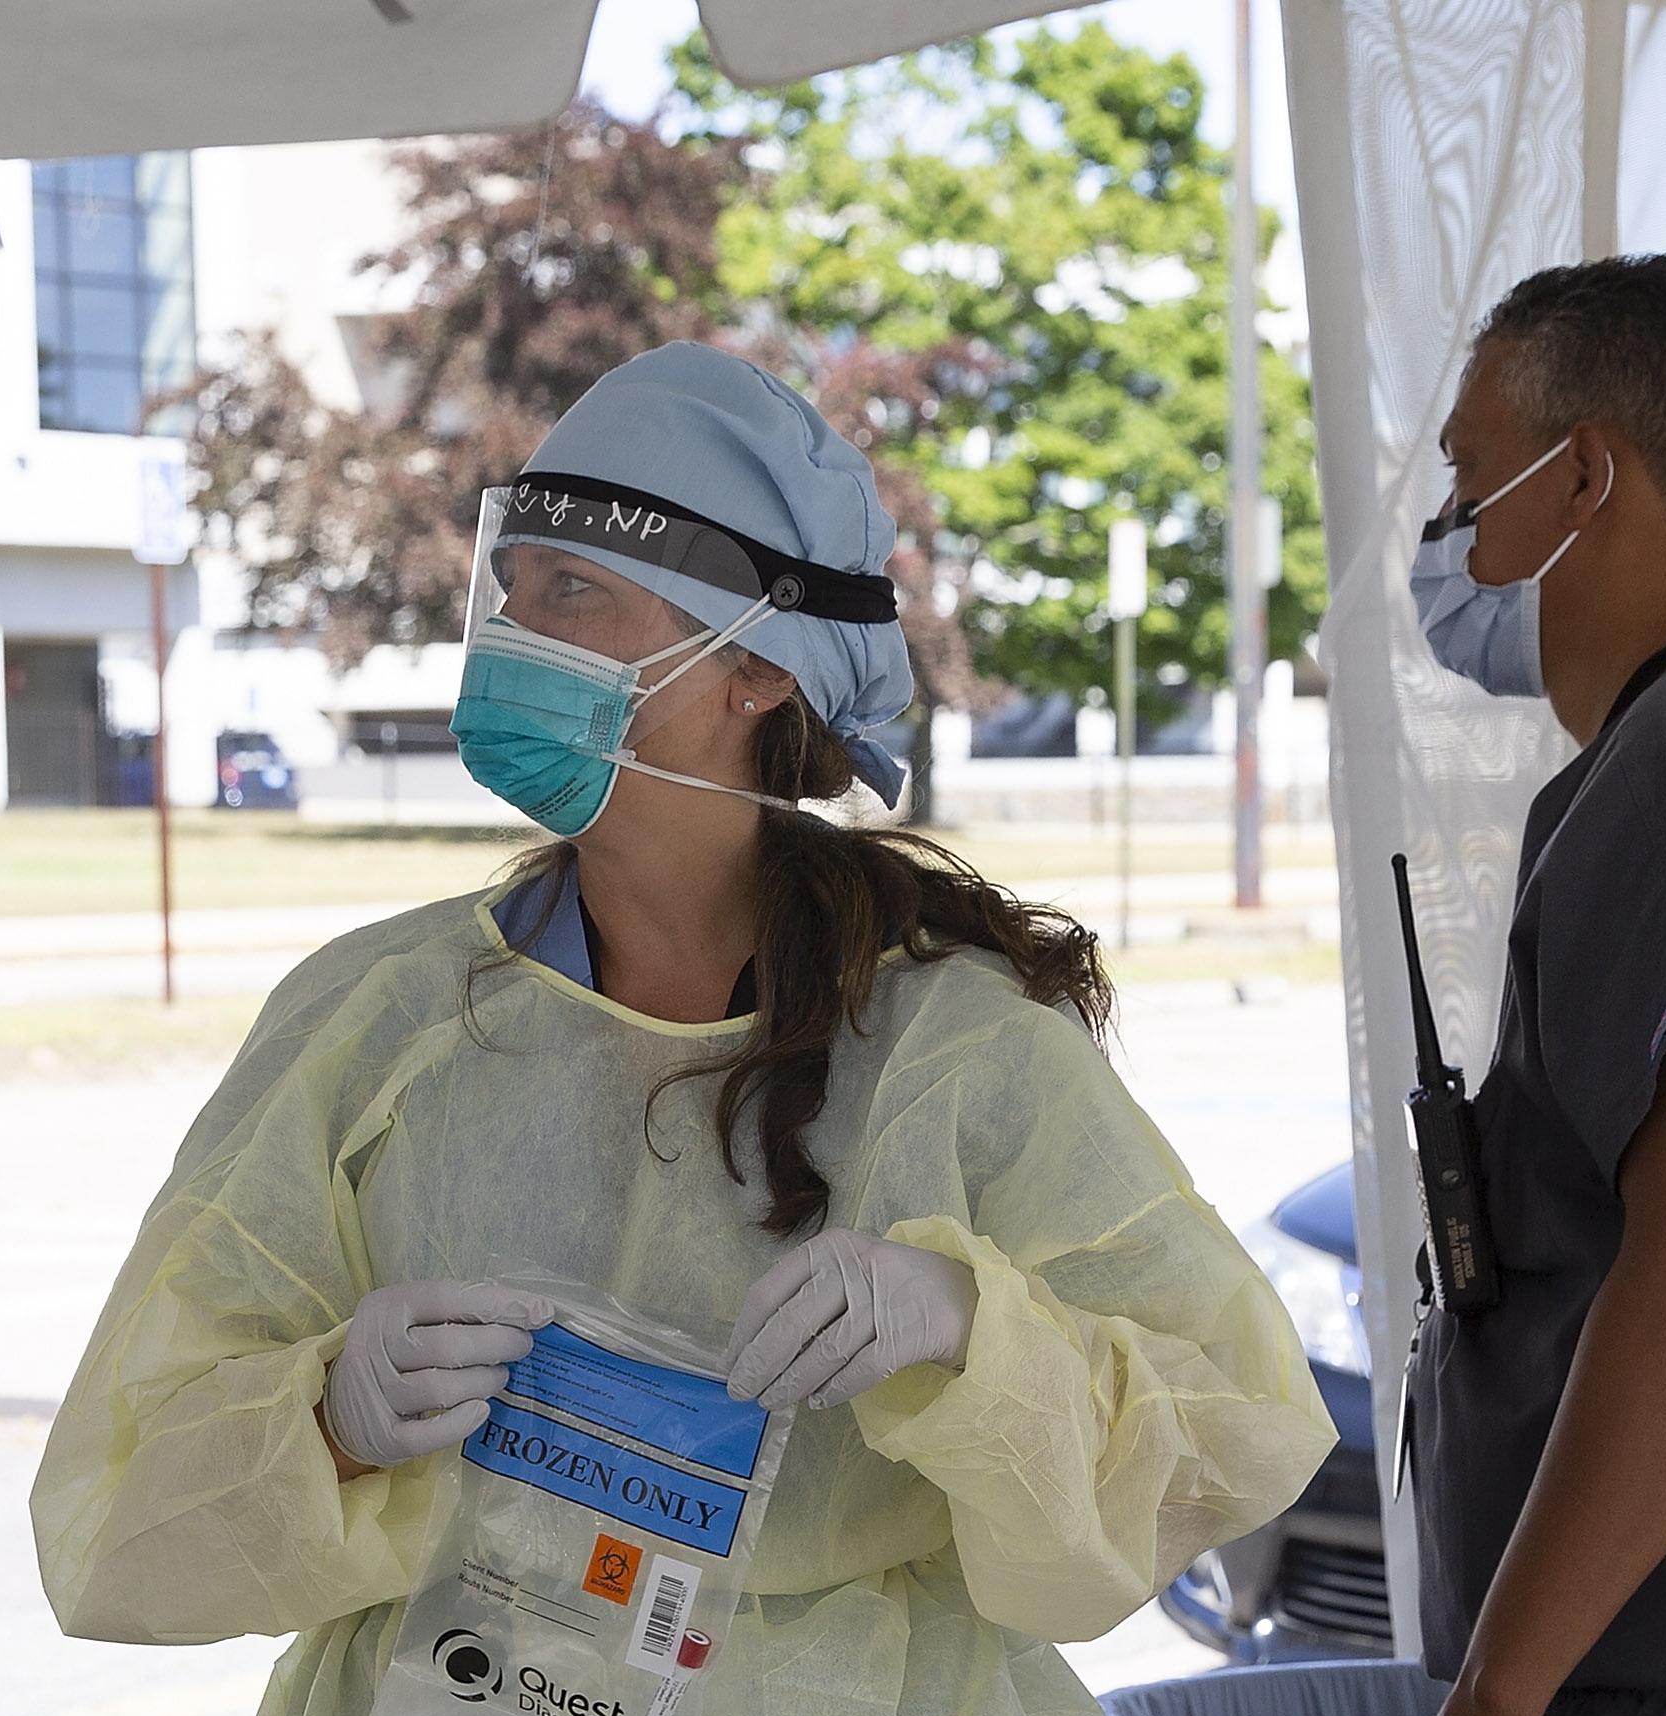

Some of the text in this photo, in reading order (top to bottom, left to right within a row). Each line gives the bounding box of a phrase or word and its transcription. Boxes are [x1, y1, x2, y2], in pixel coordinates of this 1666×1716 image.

[605, 501, 667, 541] NP
[478, 1418, 723, 1533] FROZEN ONLY
[457, 1573, 515, 1604] Route Number
[462, 1558, 520, 1588] Client Number
